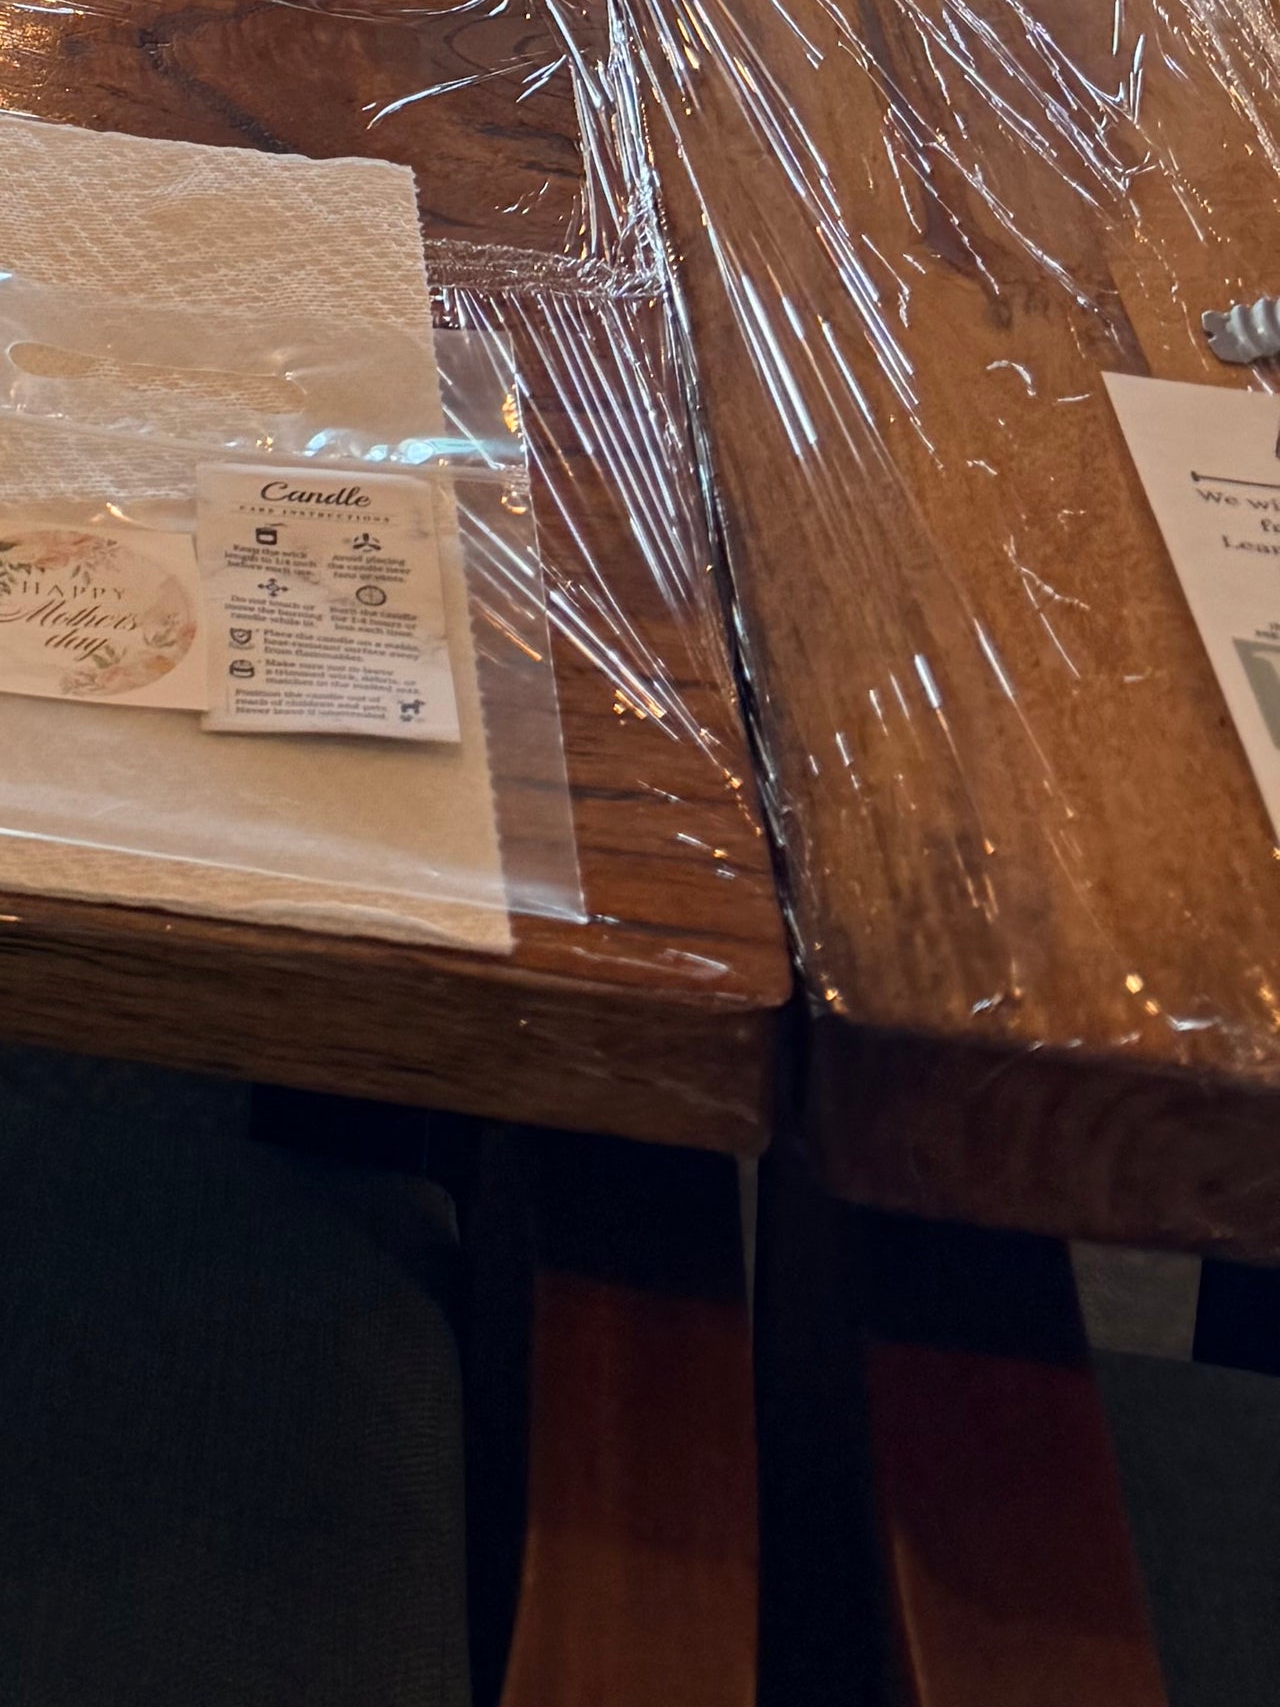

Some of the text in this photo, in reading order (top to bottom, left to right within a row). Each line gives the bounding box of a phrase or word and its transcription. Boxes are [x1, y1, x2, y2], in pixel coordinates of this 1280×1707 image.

[259, 480, 373, 509] Candle
[22, 580, 125, 601] HAPPY
[43, 628, 109, 662] day
